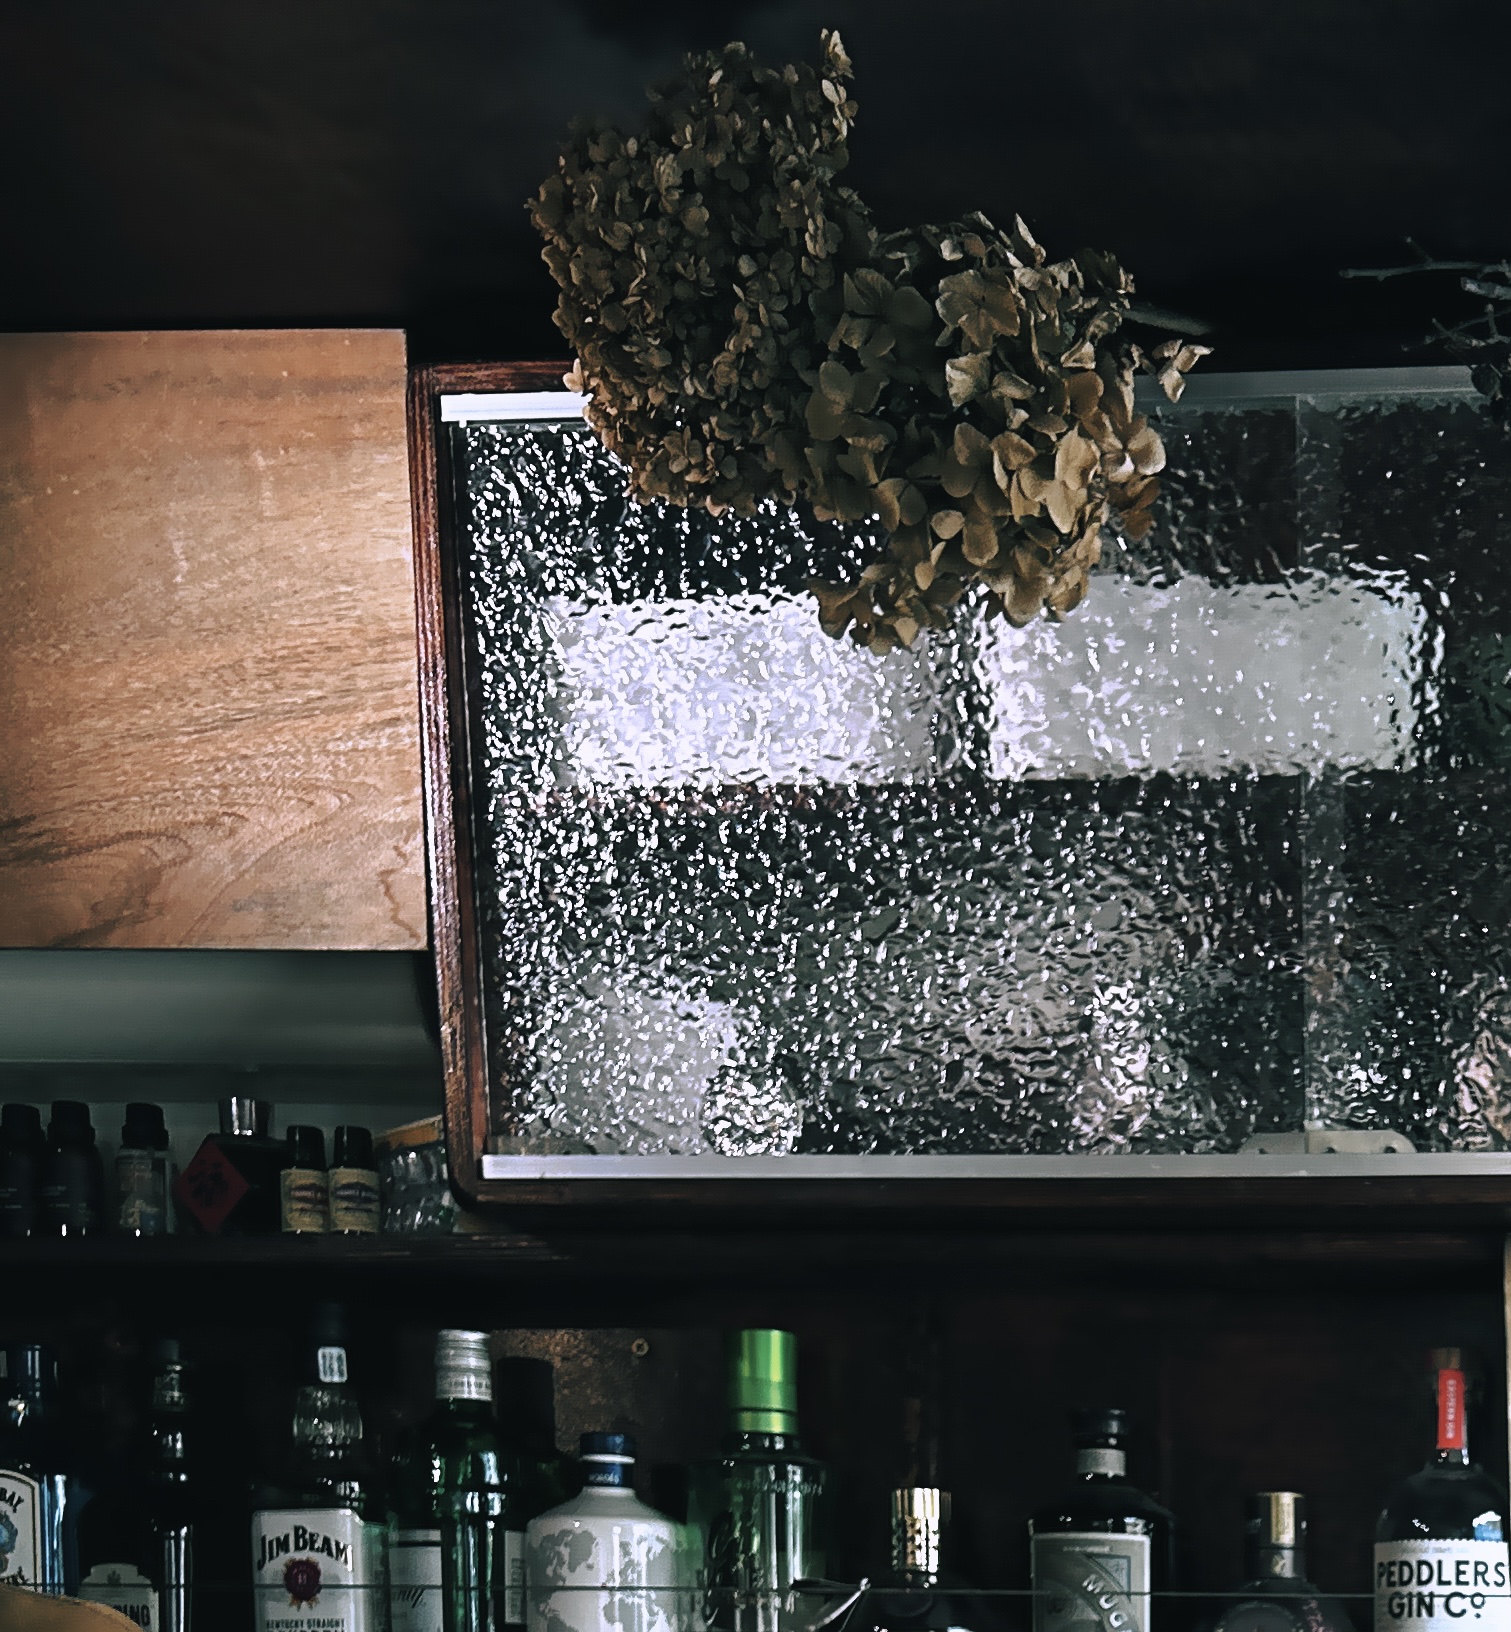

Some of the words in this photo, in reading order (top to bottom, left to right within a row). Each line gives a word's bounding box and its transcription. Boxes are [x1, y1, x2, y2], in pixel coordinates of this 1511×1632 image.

[257, 1533, 290, 1571] JIM
[293, 1525, 352, 1568] BEAM
[1377, 1559, 1506, 1588] PEDDLERS
[1388, 1591, 1435, 1619] GIN
